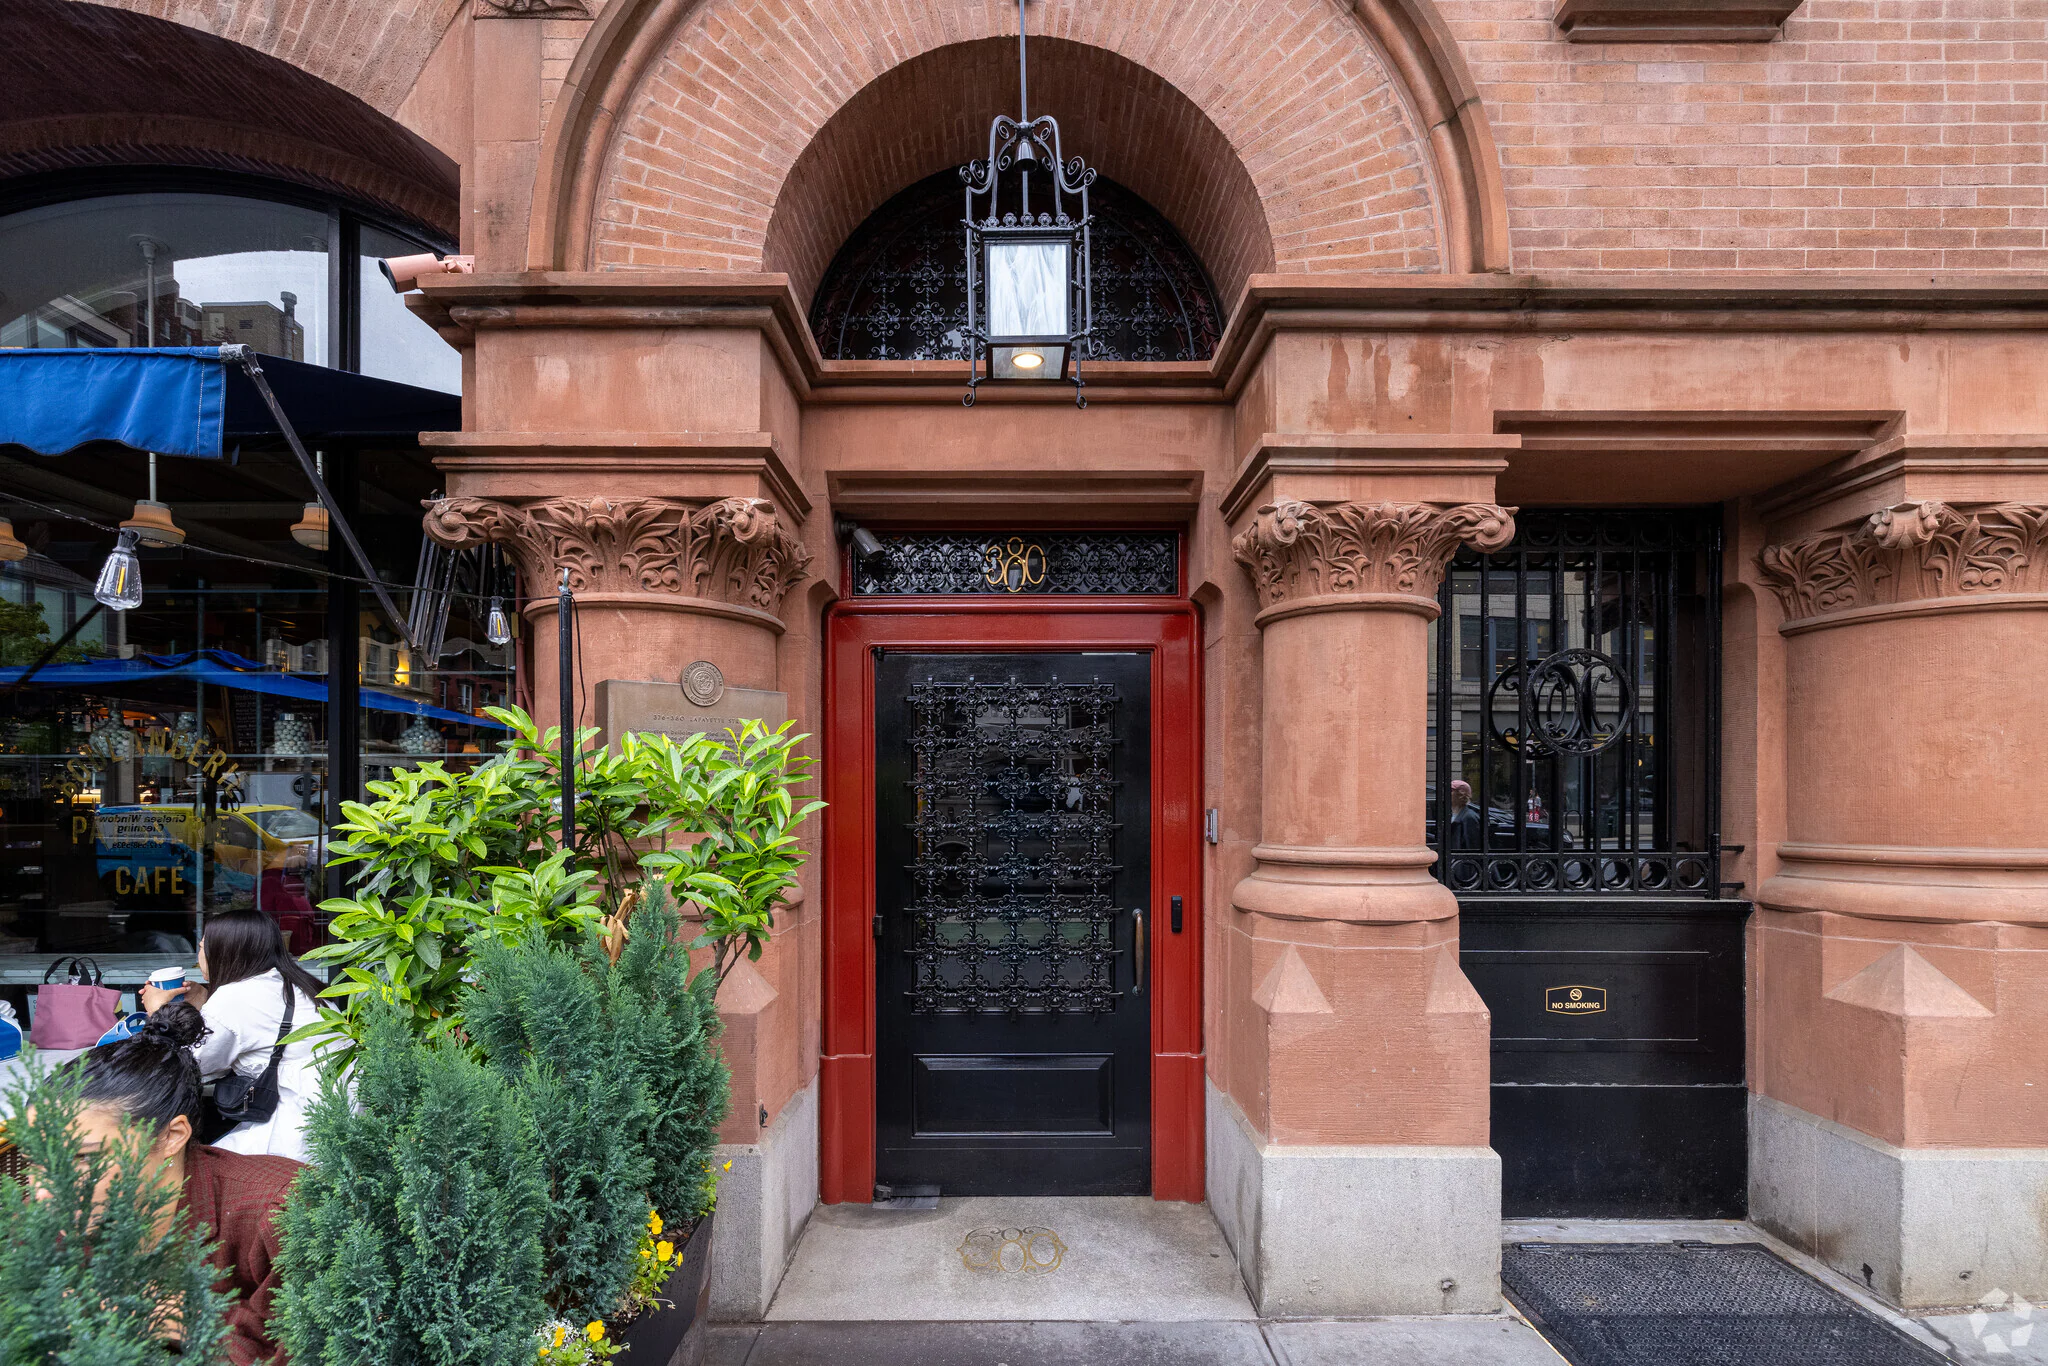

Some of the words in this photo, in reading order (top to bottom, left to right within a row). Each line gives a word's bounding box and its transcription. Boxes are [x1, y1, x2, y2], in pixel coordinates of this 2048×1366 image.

[985, 536, 1046, 592] 380
[52, 729, 241, 798] BOULANGERIE
[115, 858, 184, 895] CAFÉ
